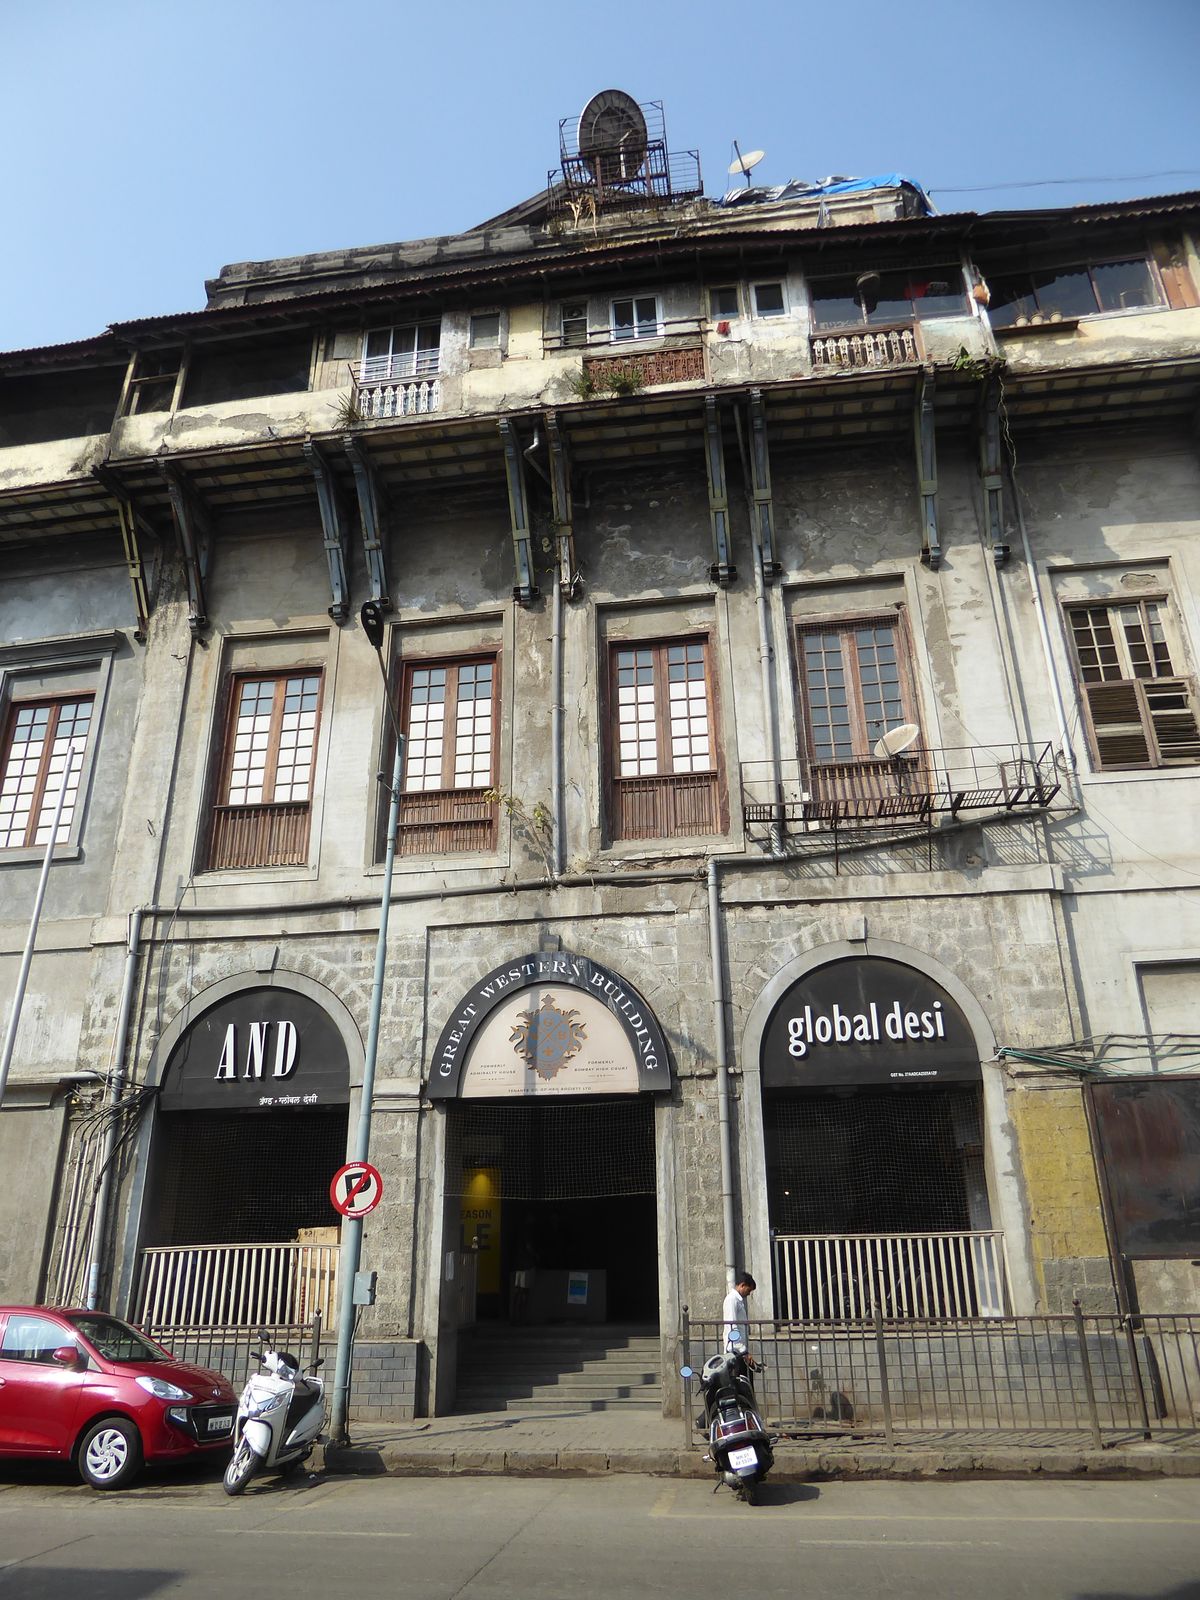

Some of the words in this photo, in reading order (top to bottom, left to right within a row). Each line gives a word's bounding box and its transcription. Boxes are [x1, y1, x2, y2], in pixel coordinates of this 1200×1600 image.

[439, 1002, 478, 1077] GREAT
[480, 960, 581, 1000] WESTERN
[590, 971, 659, 1070] BUILDING
[788, 1002, 880, 1057] global
[885, 1000, 945, 1039] desi
[214, 1020, 297, 1079] AND
[345, 1172, 371, 1208] P
